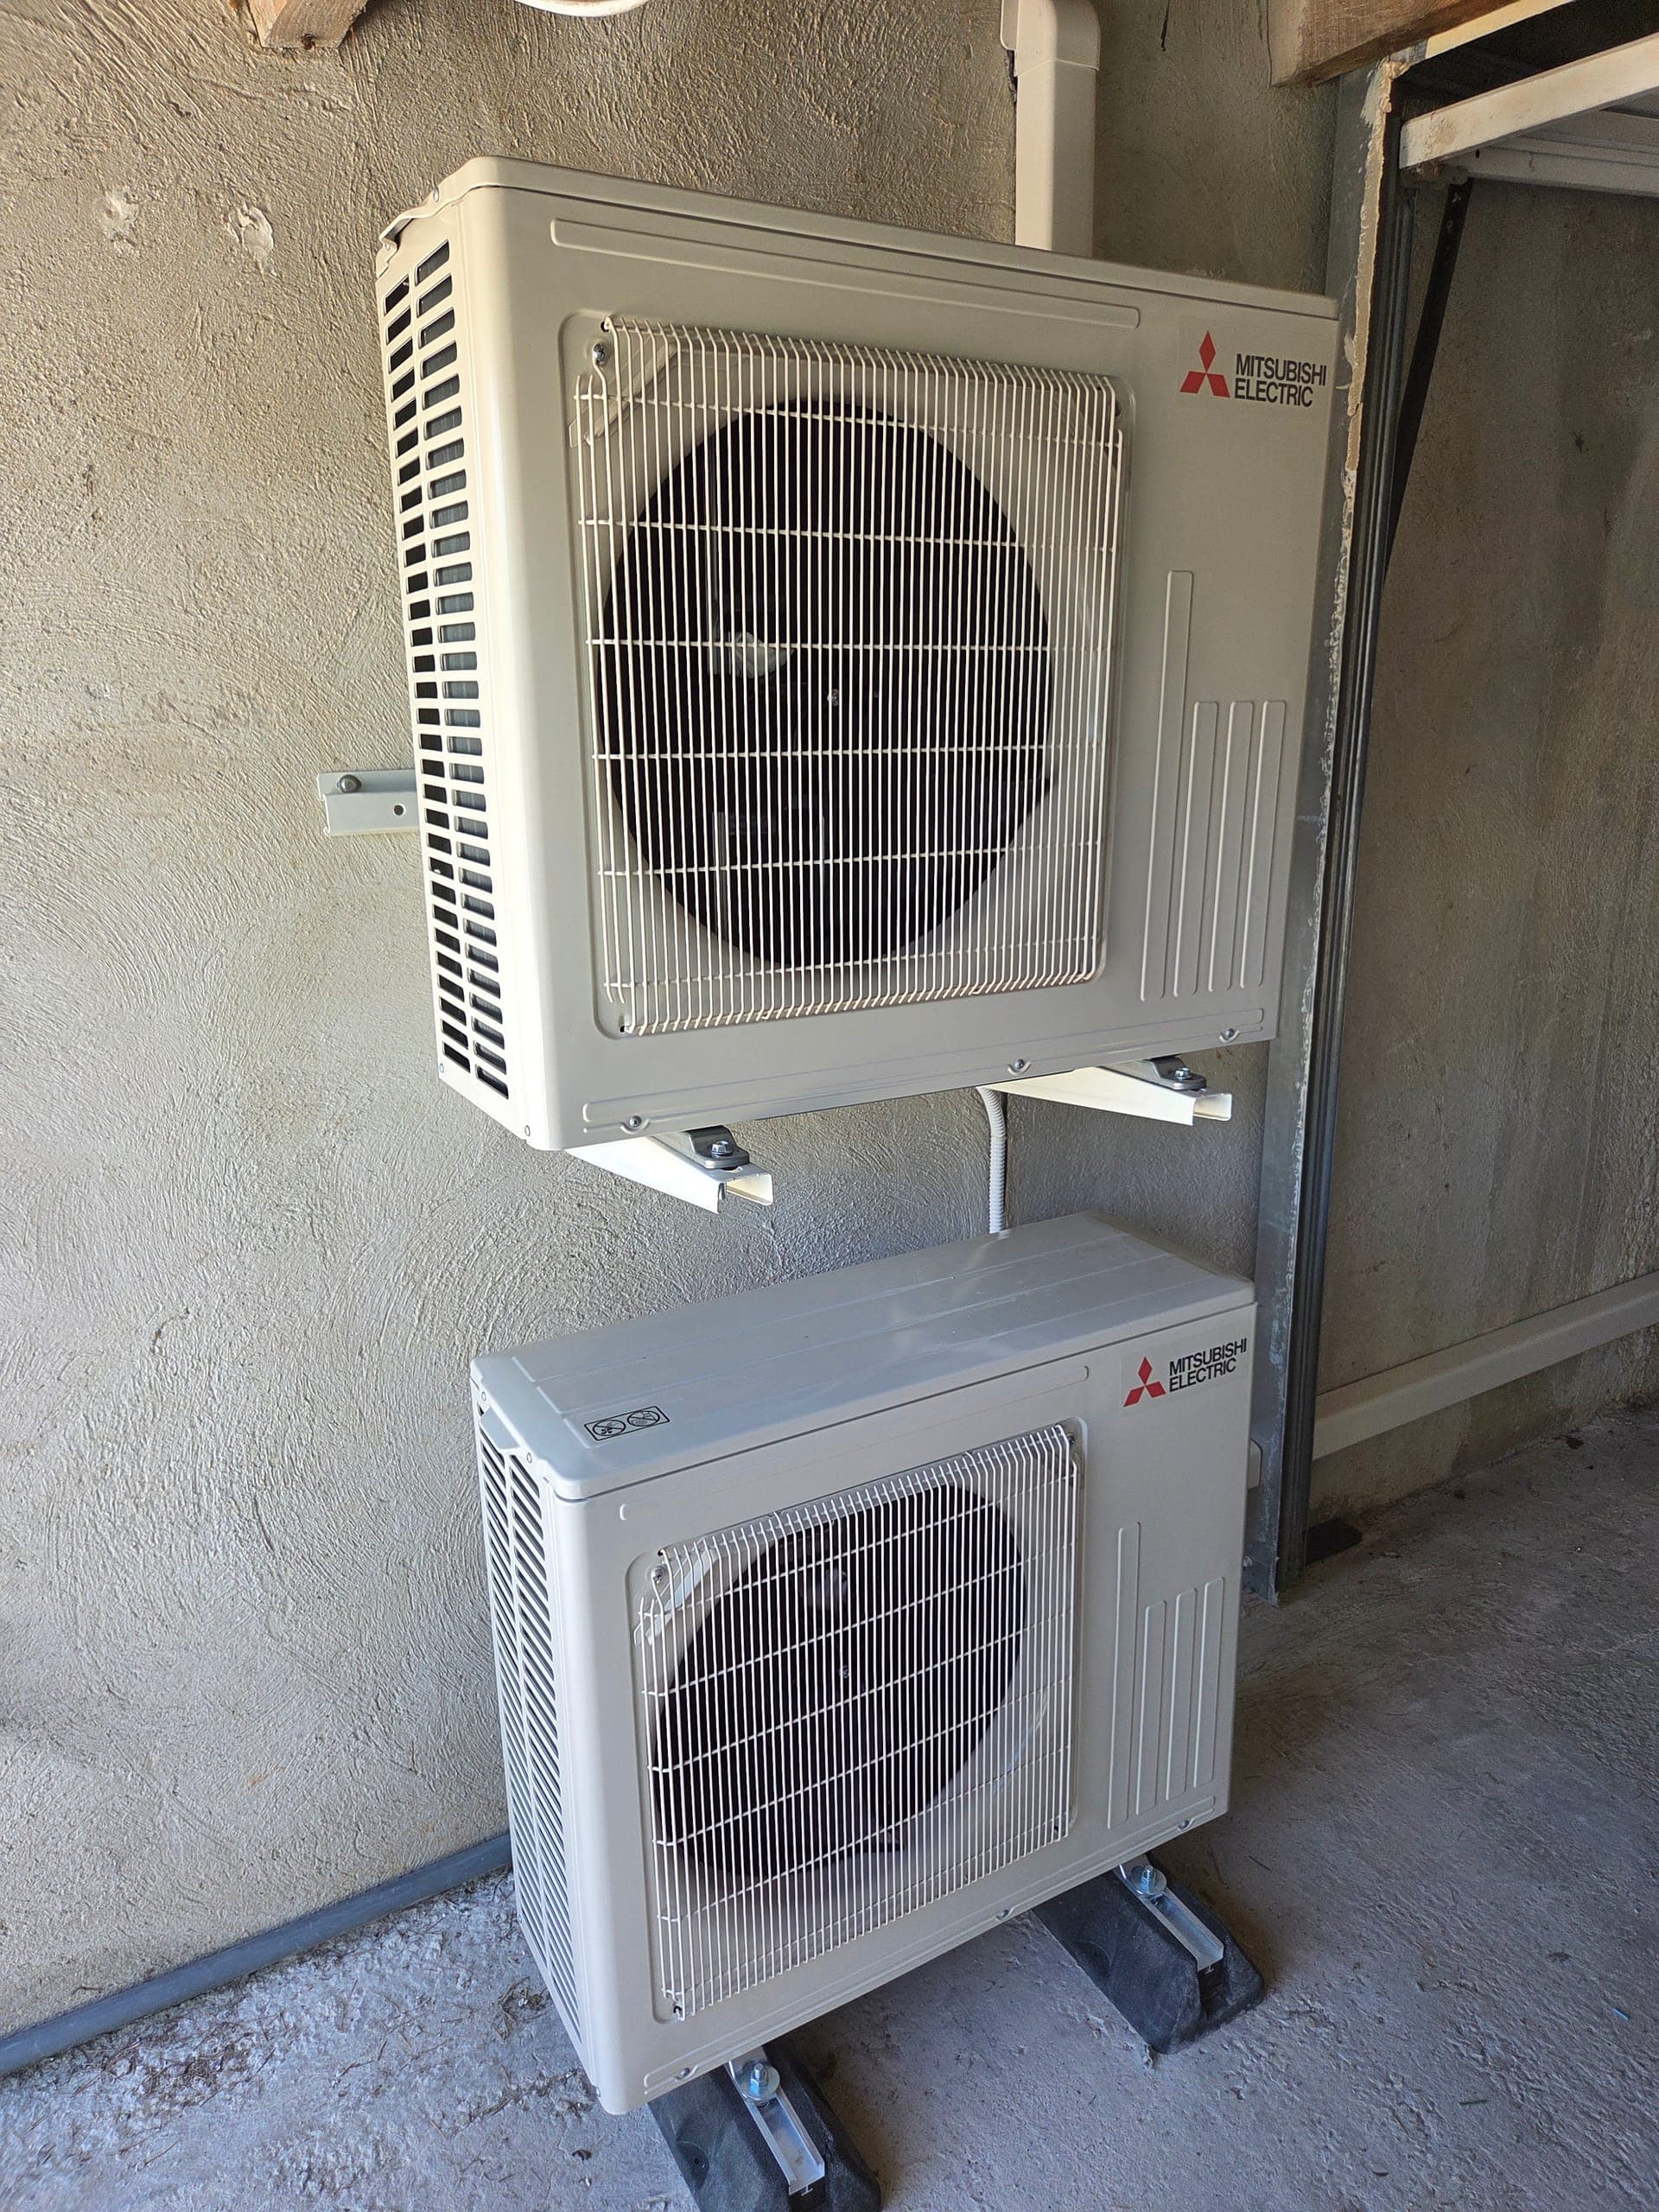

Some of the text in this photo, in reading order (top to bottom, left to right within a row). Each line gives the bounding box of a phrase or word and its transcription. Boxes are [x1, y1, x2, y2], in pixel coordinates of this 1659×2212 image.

[1236, 353, 1326, 386] MITSUBISHI
[1234, 378, 1313, 407] ELECTRIC
[1169, 1338, 1247, 1376] MITSUBISHI
[1169, 1357, 1236, 1392] ELECTRIC
